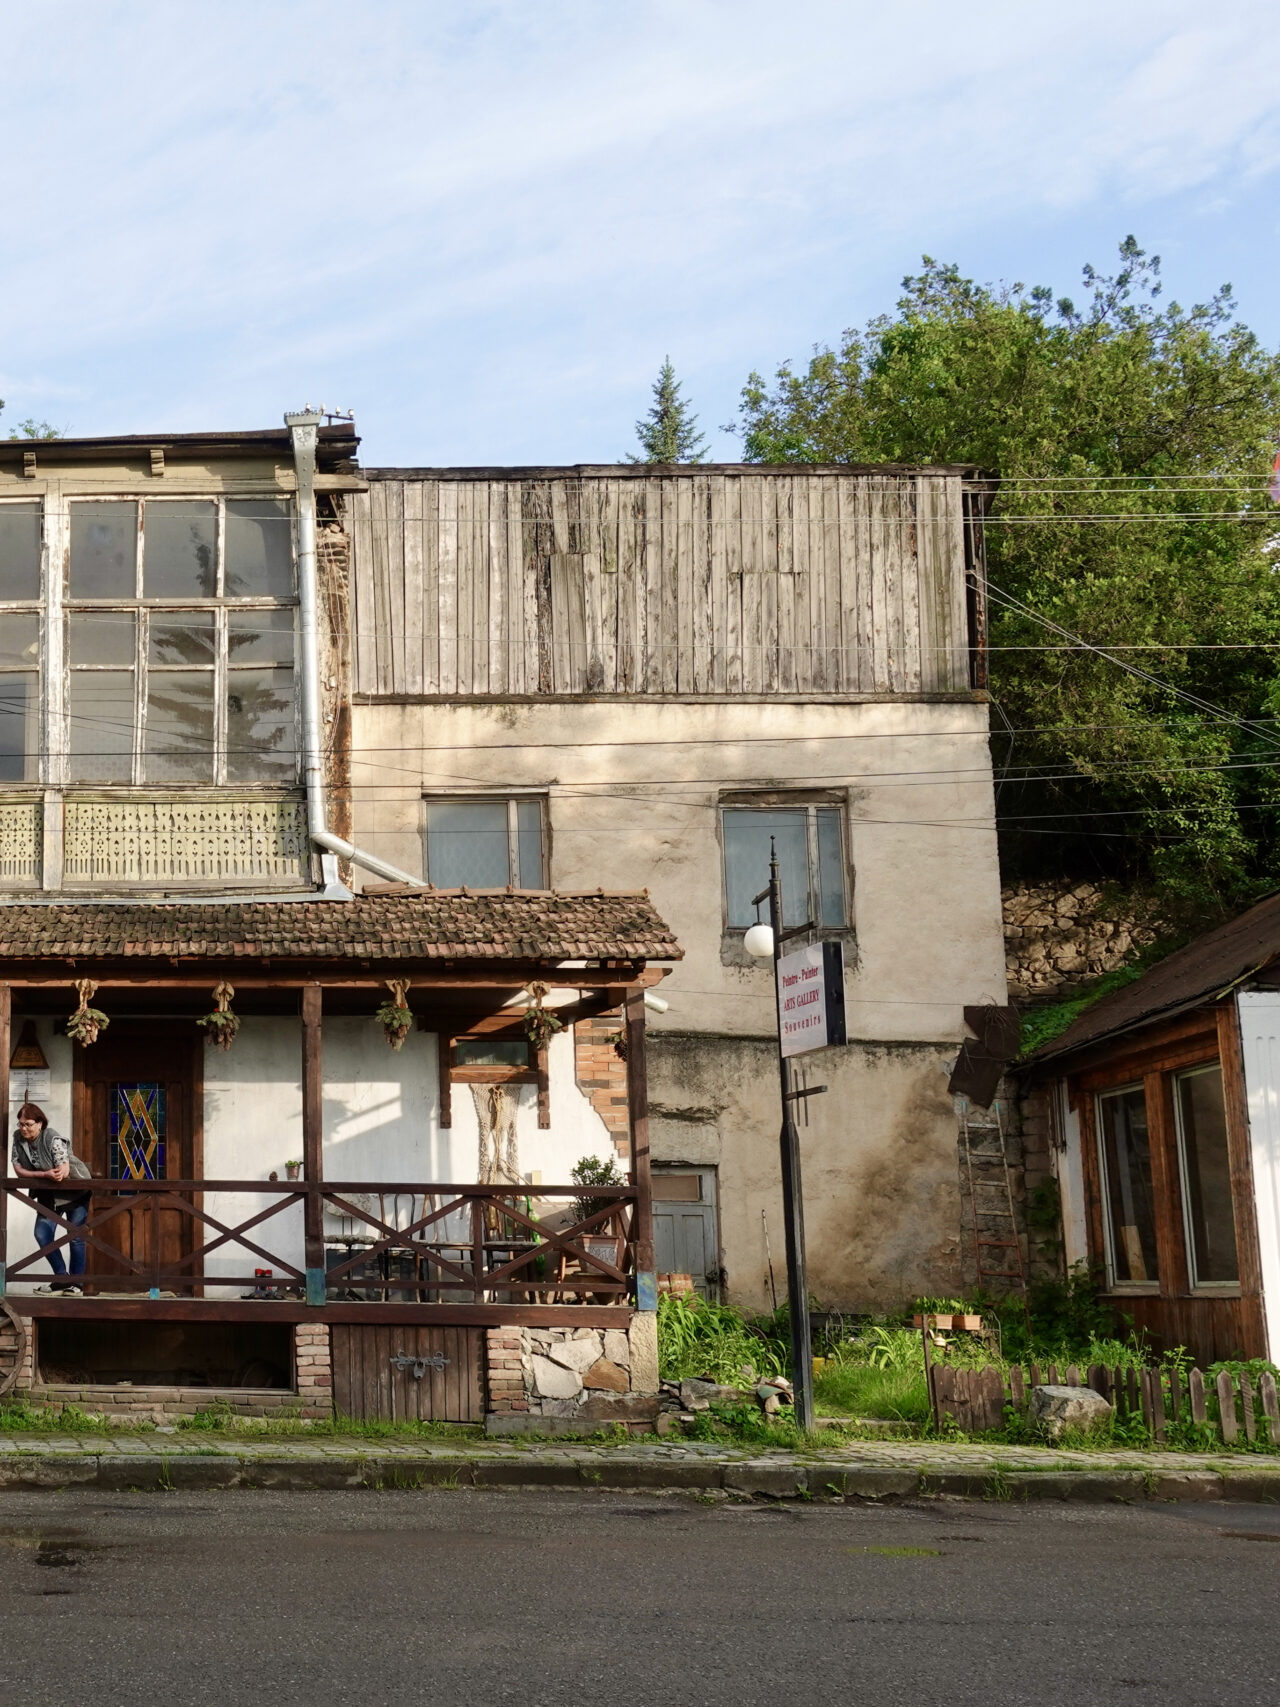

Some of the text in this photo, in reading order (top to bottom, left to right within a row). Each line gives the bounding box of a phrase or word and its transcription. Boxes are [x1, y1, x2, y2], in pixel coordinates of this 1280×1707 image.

[782, 974, 798, 988] Peintre
[801, 967, 819, 982] Painter
[784, 989, 820, 1012] ARTS GALLERY
[784, 1014, 821, 1034] Souvenirs
